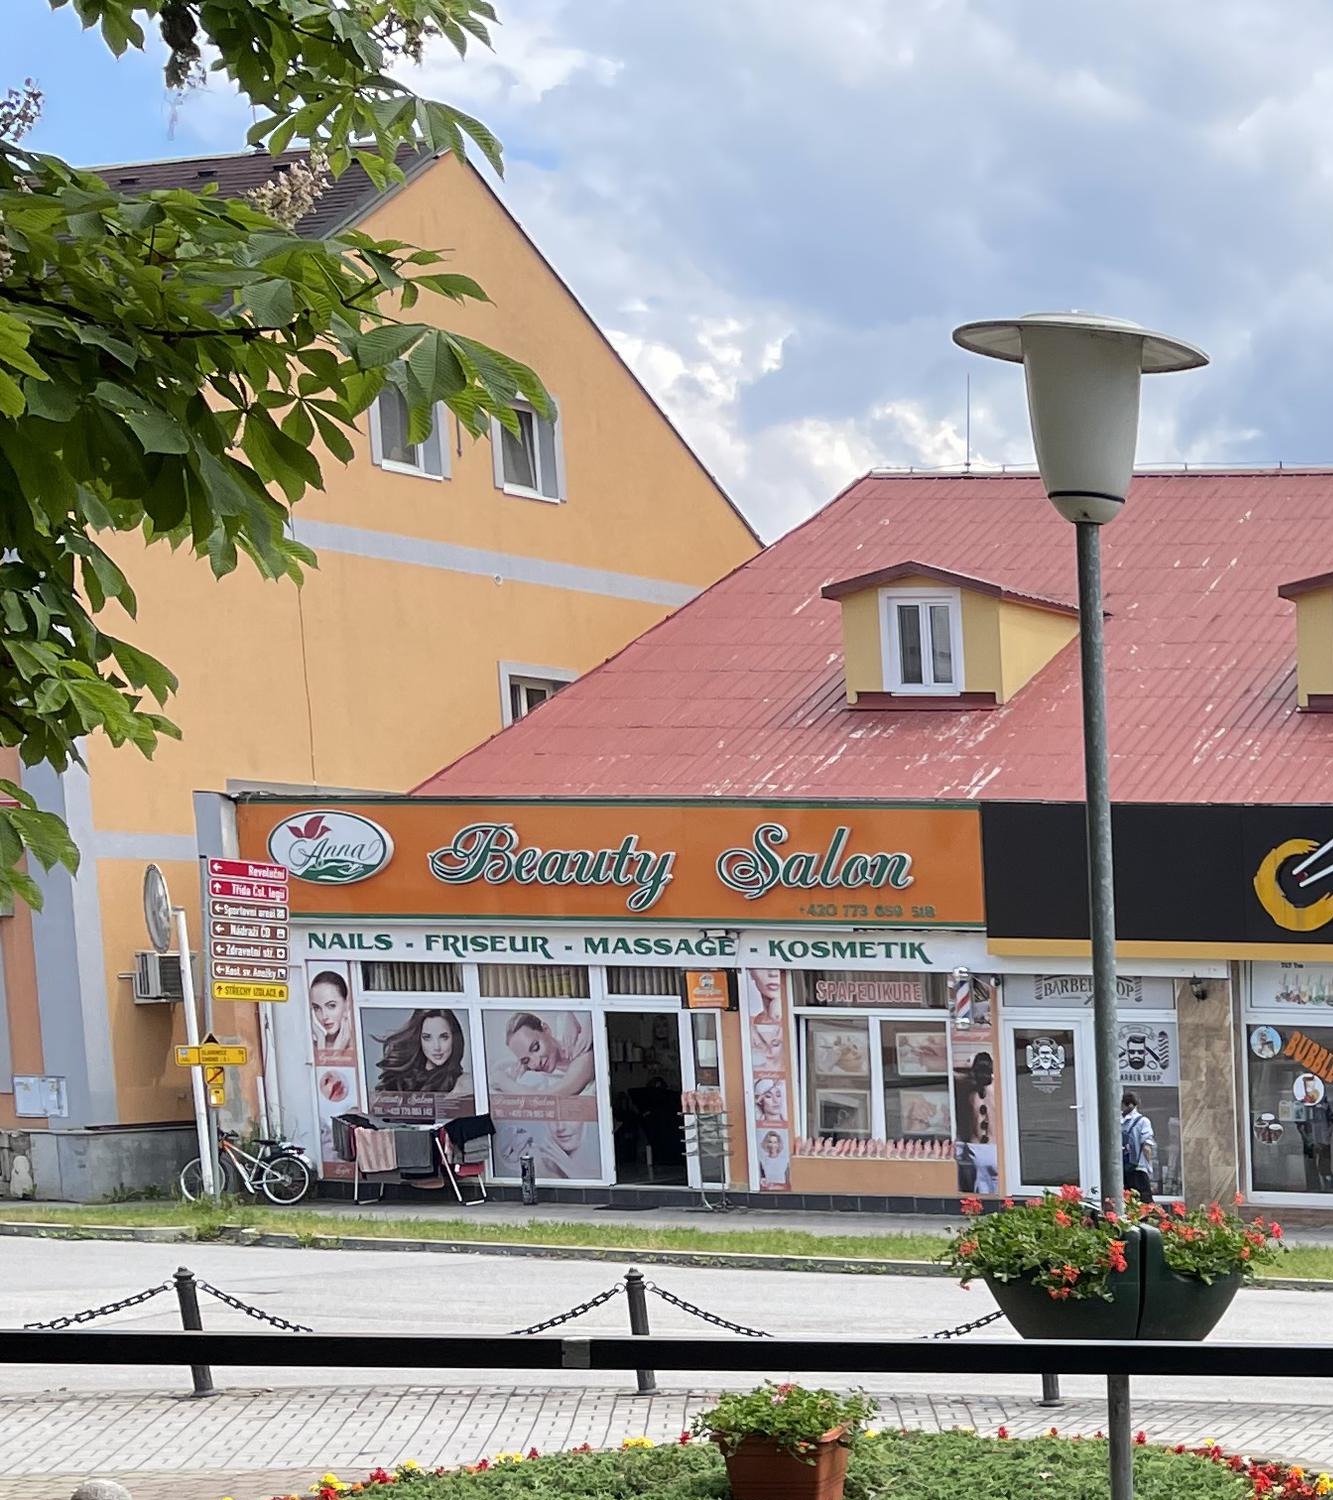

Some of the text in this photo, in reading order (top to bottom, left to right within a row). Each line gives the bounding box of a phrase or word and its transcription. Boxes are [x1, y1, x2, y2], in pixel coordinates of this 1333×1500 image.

[289, 838, 382, 870] Anna
[427, 822, 915, 912] Beauty Salon
[308, 932, 393, 950] NAILS
[425, 934, 554, 959] FRISEUR
[584, 937, 736, 956] MASSAGE
[768, 940, 933, 964] KOSMETIK
